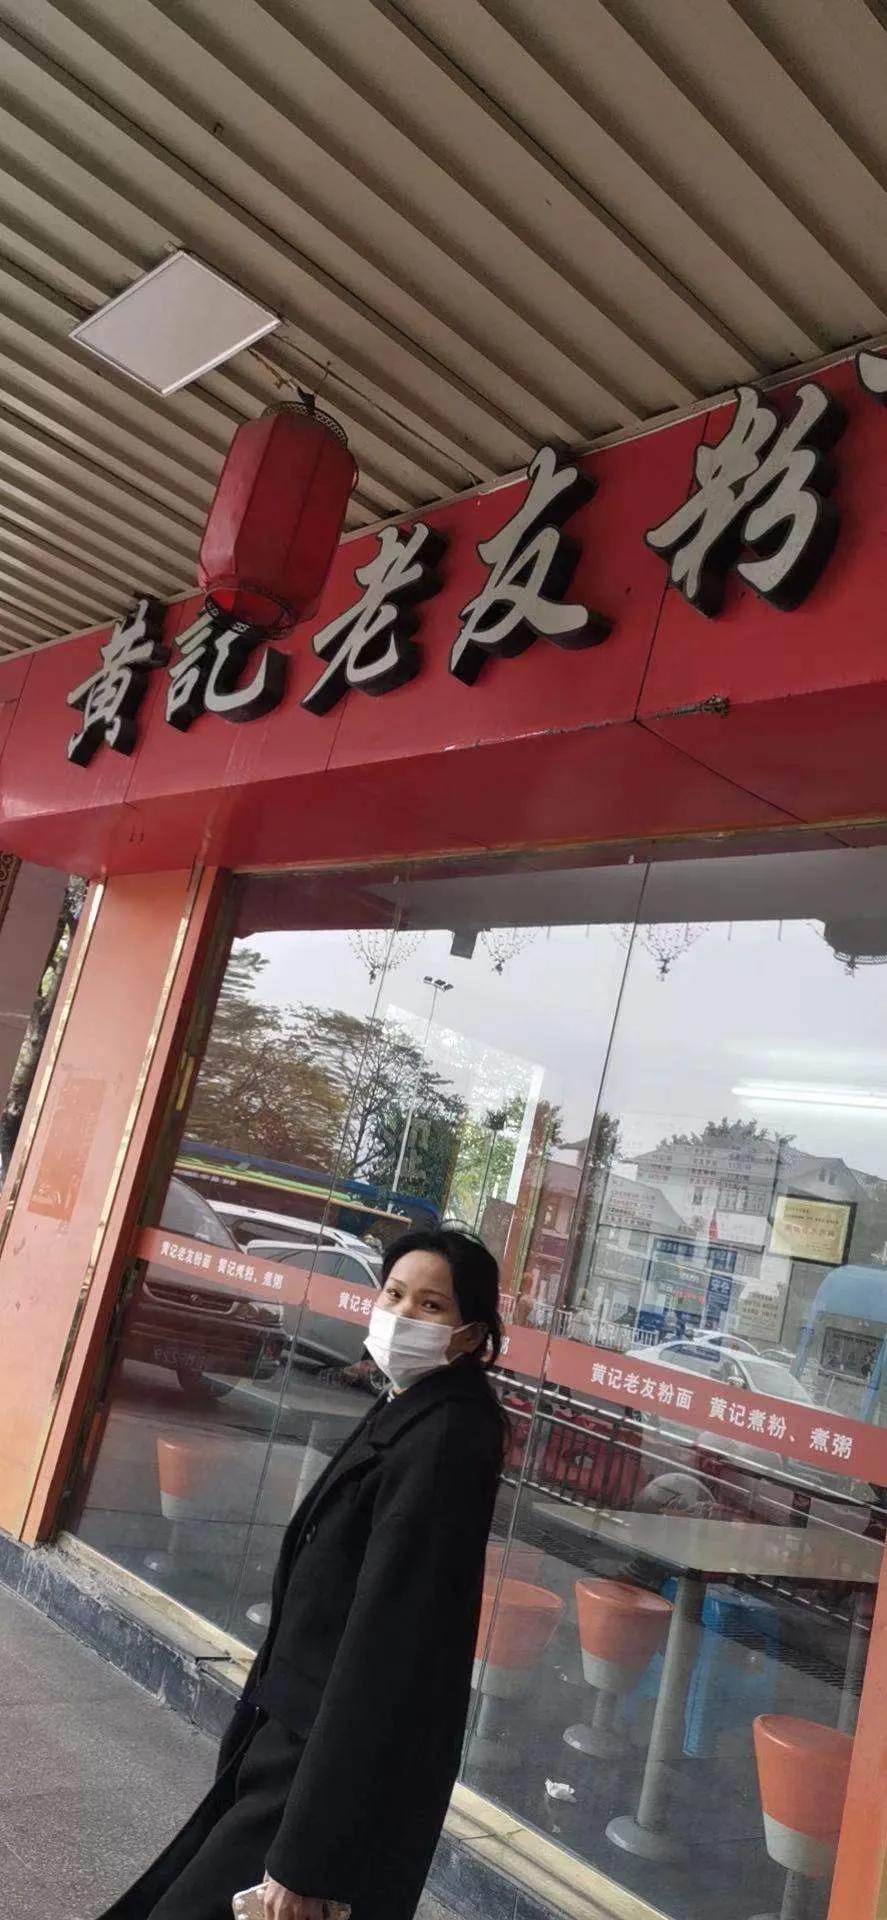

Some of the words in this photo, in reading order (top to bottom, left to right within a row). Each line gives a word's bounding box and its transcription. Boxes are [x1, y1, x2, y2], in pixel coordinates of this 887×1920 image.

[67, 352, 887, 760] 黄記老友粉
[590, 1362, 697, 1412] 黄记老友粉面
[708, 1396, 853, 1461] 黄记煮粉、煮粥
